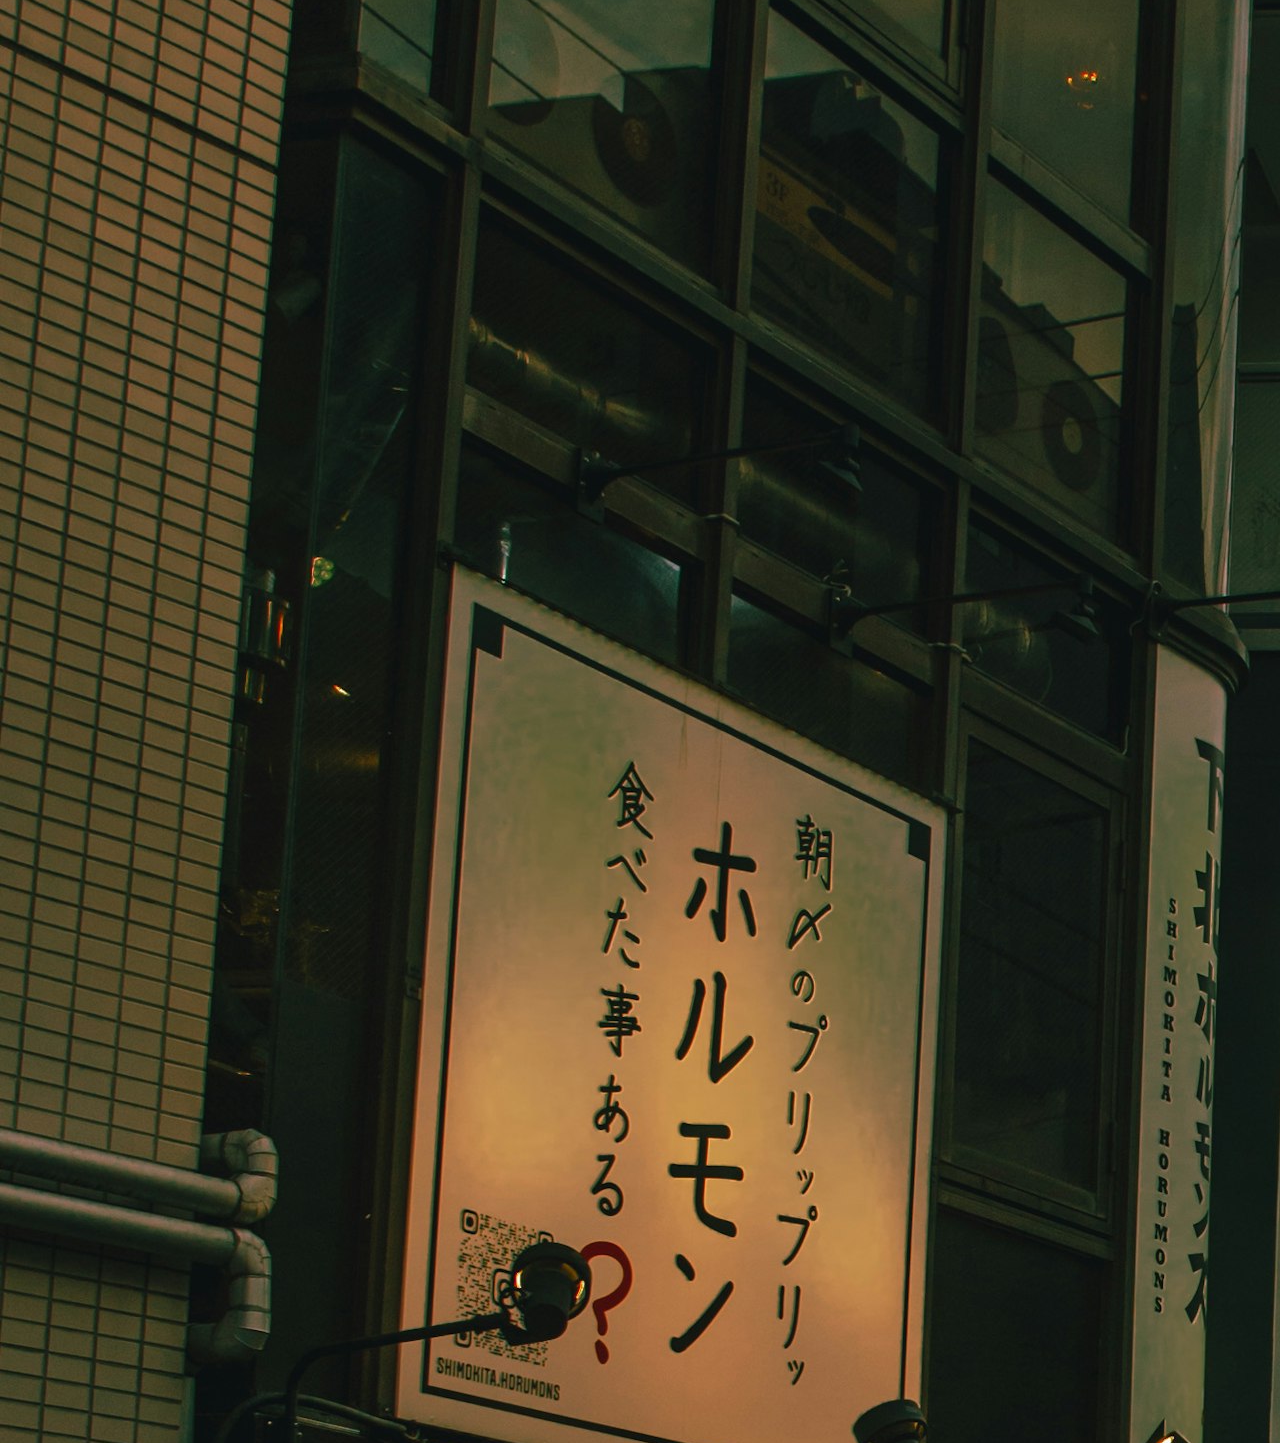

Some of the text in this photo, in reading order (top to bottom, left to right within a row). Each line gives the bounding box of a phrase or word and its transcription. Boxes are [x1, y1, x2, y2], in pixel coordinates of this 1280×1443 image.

[668, 820, 757, 1355] ホルモン
[777, 813, 835, 1387] 朝〆のプリップリッ
[1152, 898, 1178, 1314] SHIMOKITA HORUMONS
